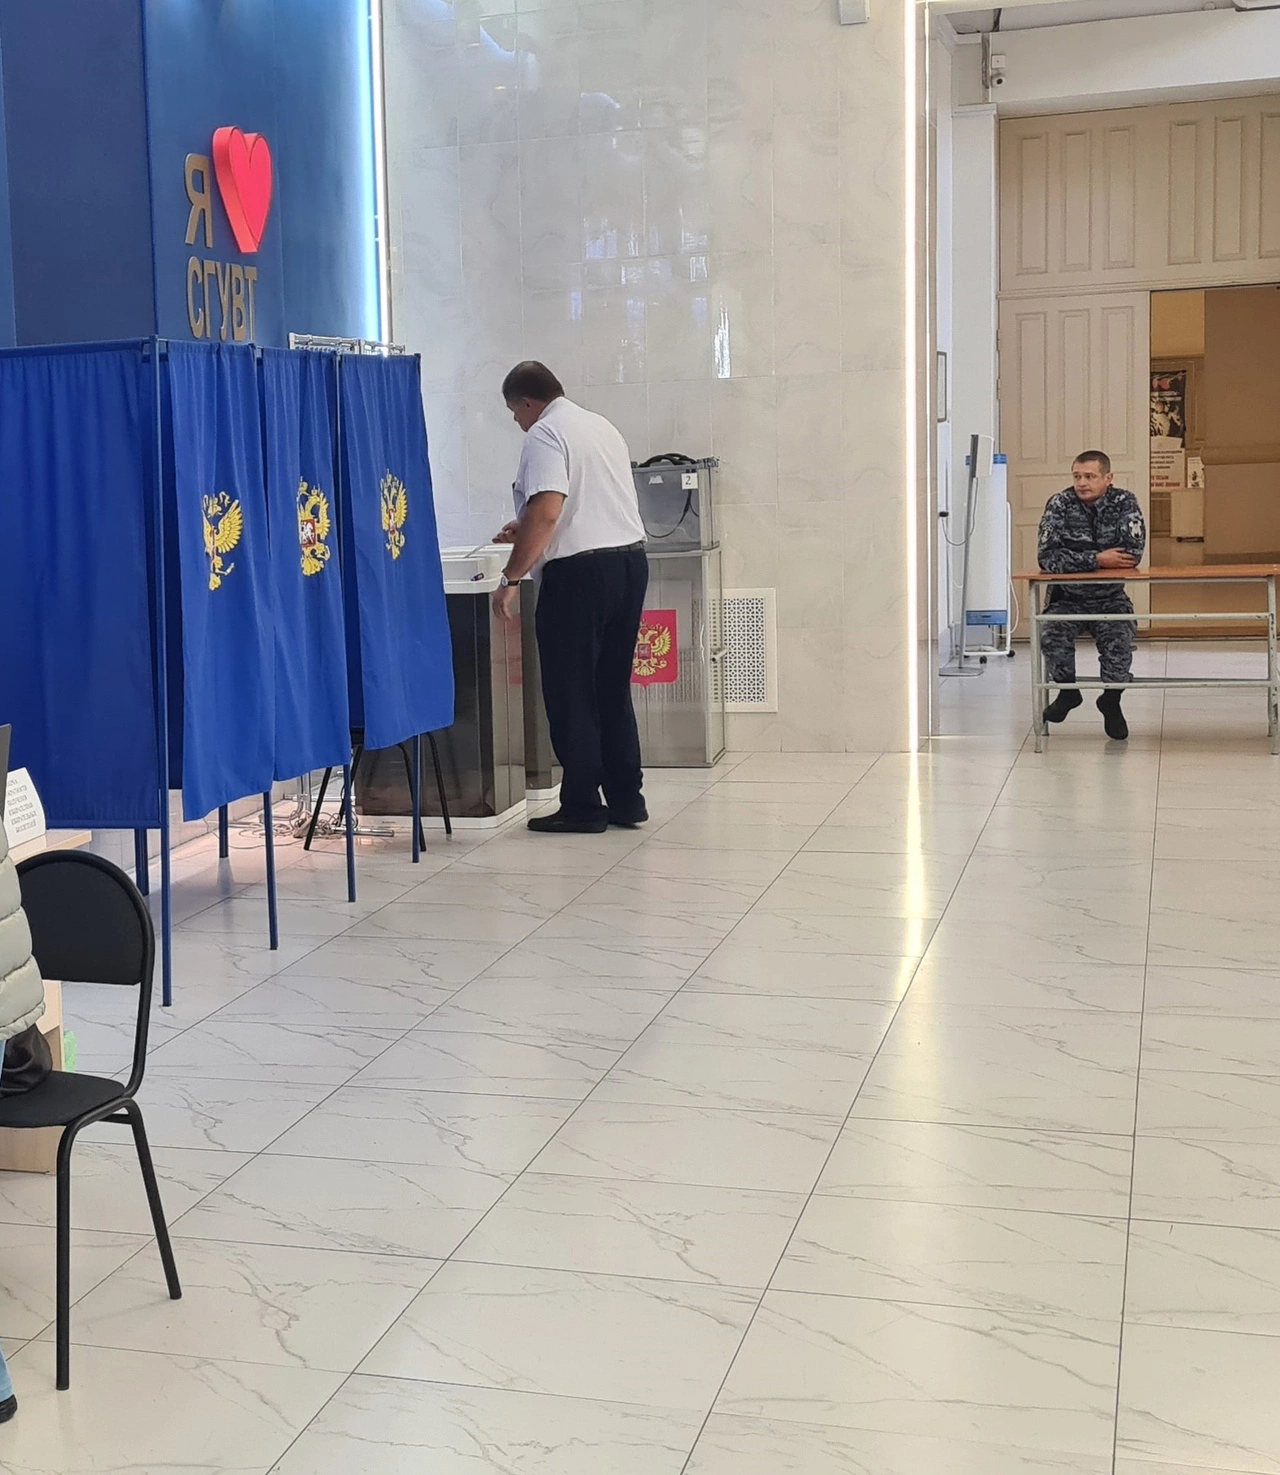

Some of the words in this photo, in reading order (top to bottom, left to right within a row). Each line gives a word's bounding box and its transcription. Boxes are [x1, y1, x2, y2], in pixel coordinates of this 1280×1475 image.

[183, 152, 213, 248] Я
[186, 256, 258, 342] СГУВТ
[685, 475, 692, 485] 2
